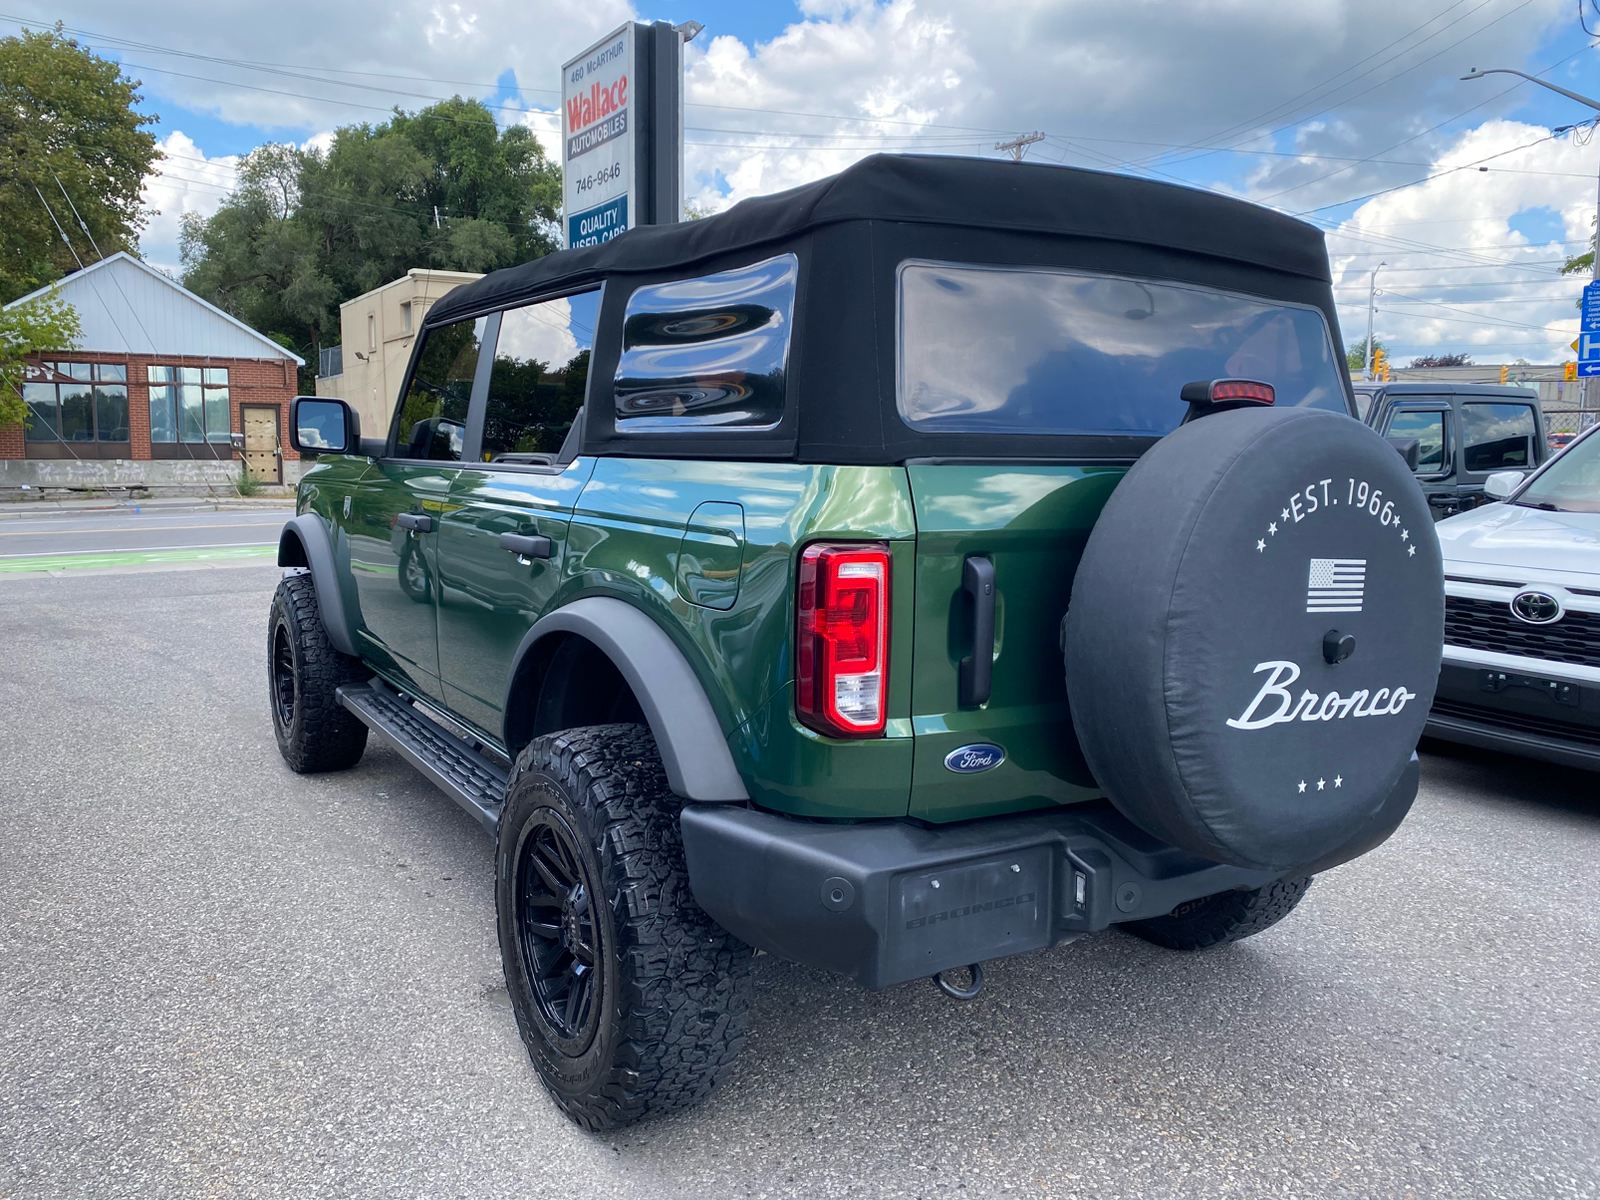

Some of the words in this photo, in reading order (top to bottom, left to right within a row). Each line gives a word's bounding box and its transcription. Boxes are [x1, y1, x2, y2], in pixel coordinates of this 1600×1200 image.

[571, 66, 584, 84] 460
[586, 40, 624, 75] McARTHUR
[566, 74, 629, 134] Wallace
[570, 113, 626, 156] AUTOMOBILES
[576, 162, 621, 195] 746-9646
[580, 207, 619, 236] QUALITY
[1290, 478, 1338, 523] EST.
[1346, 478, 1395, 526] 1966
[1225, 660, 1416, 730] Bronco
[960, 749, 993, 768] Ford
[906, 892, 1035, 930] BRONCO
